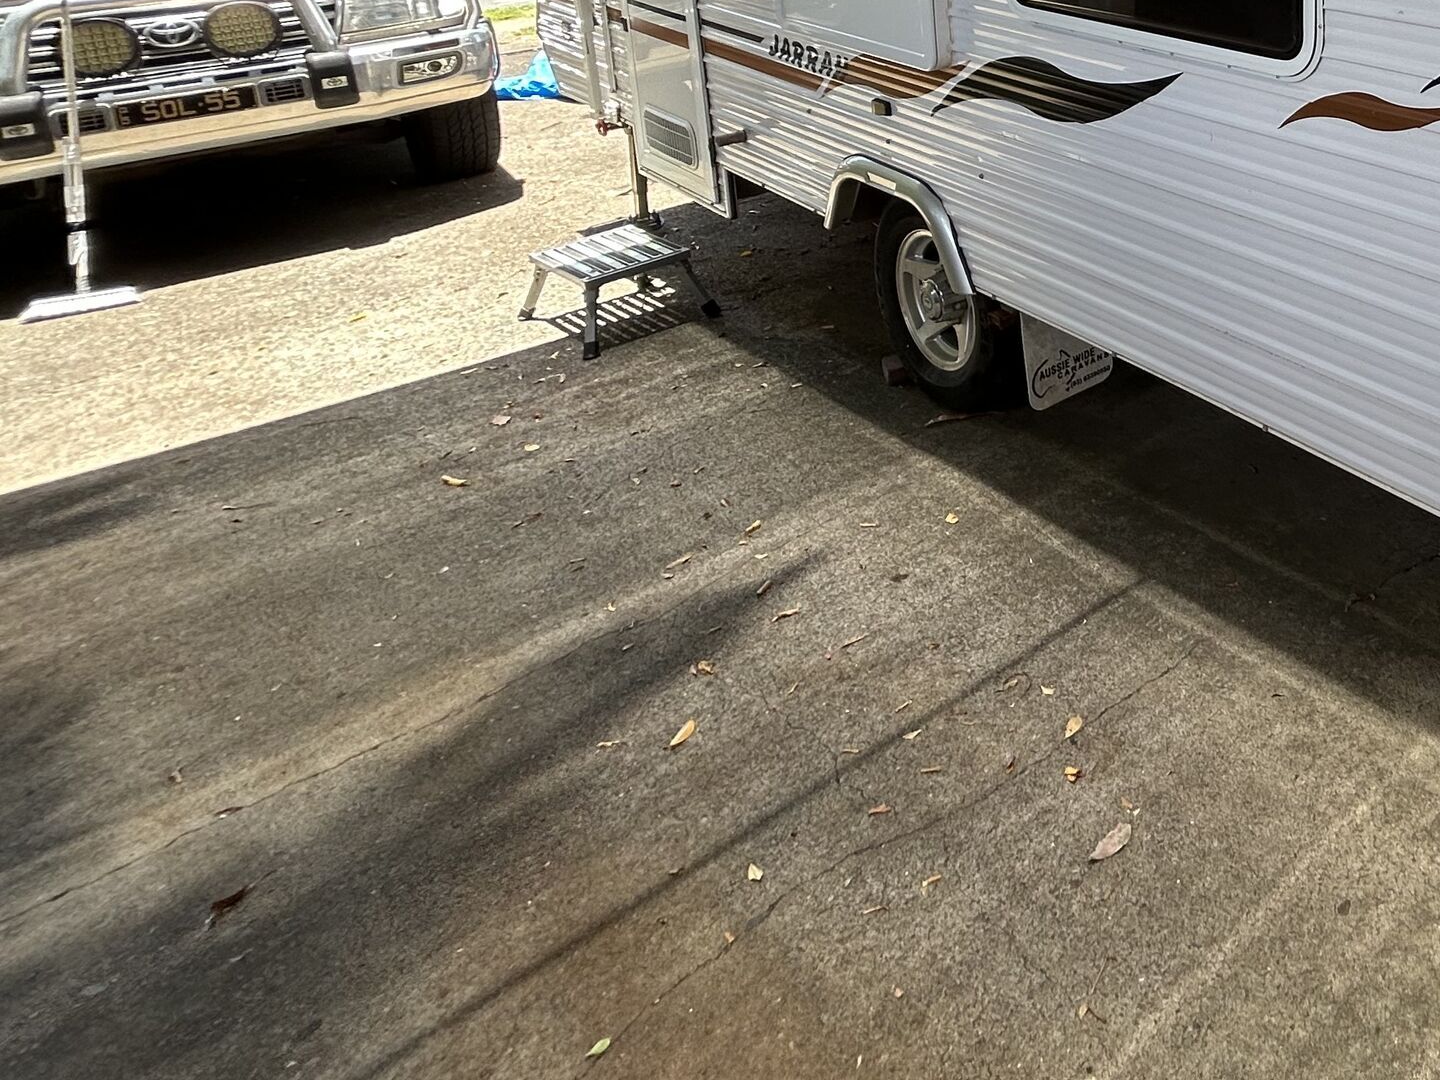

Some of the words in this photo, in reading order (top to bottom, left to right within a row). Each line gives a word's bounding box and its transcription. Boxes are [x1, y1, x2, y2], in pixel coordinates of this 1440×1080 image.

[1039, 358, 1070, 381] AUSSIE
[1072, 347, 1096, 364] WIDE
[1057, 351, 1110, 379] CARAVANS
